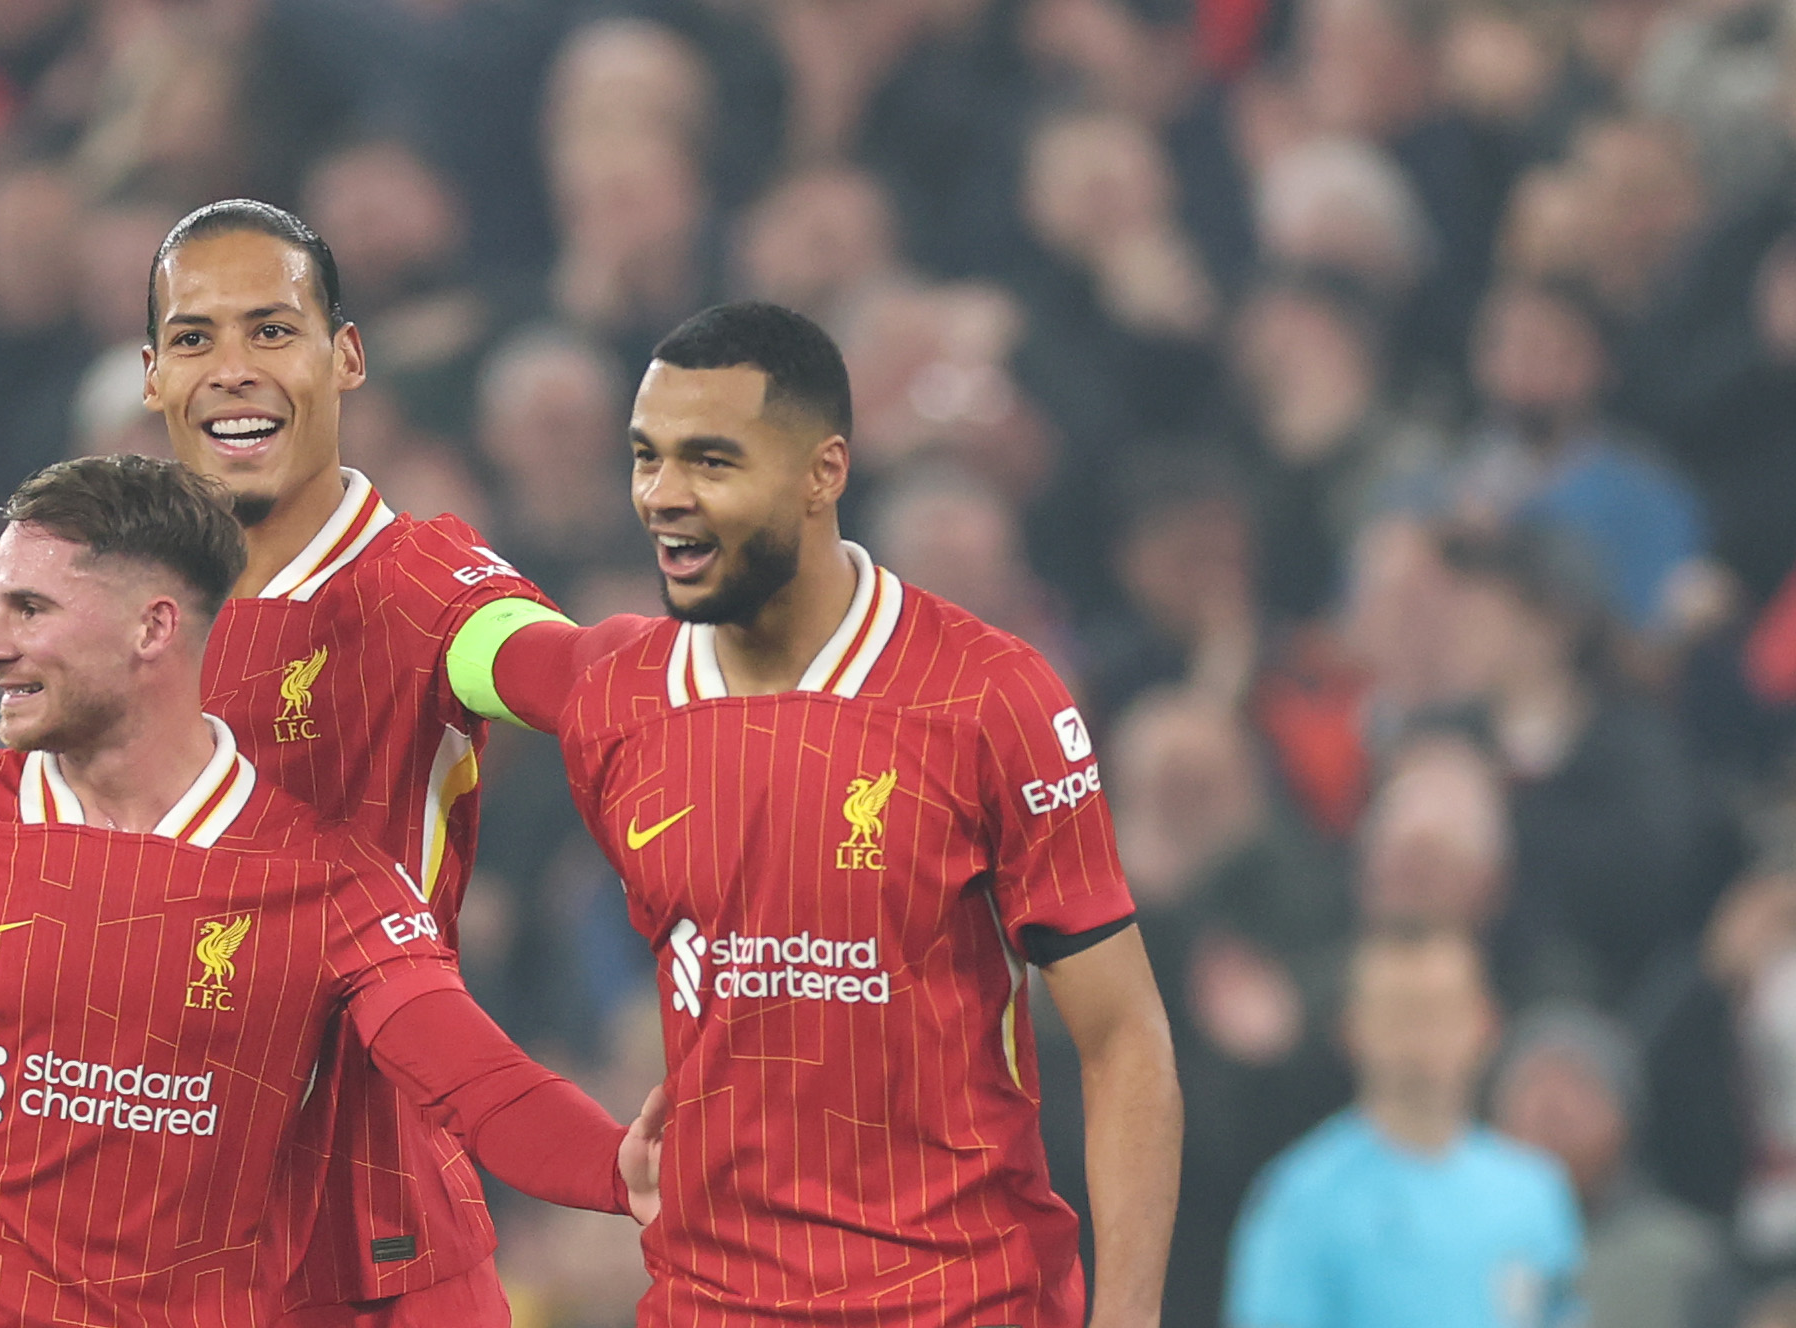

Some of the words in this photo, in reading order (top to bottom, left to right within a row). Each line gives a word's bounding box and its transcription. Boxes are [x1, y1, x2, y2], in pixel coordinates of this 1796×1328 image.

[1021, 761, 1101, 815] Expe
[380, 912, 438, 945] Exp
[711, 930, 877, 970] standard
[714, 964, 890, 1004] chartered
[23, 1050, 214, 1102] standard
[20, 1085, 218, 1136] chartered
